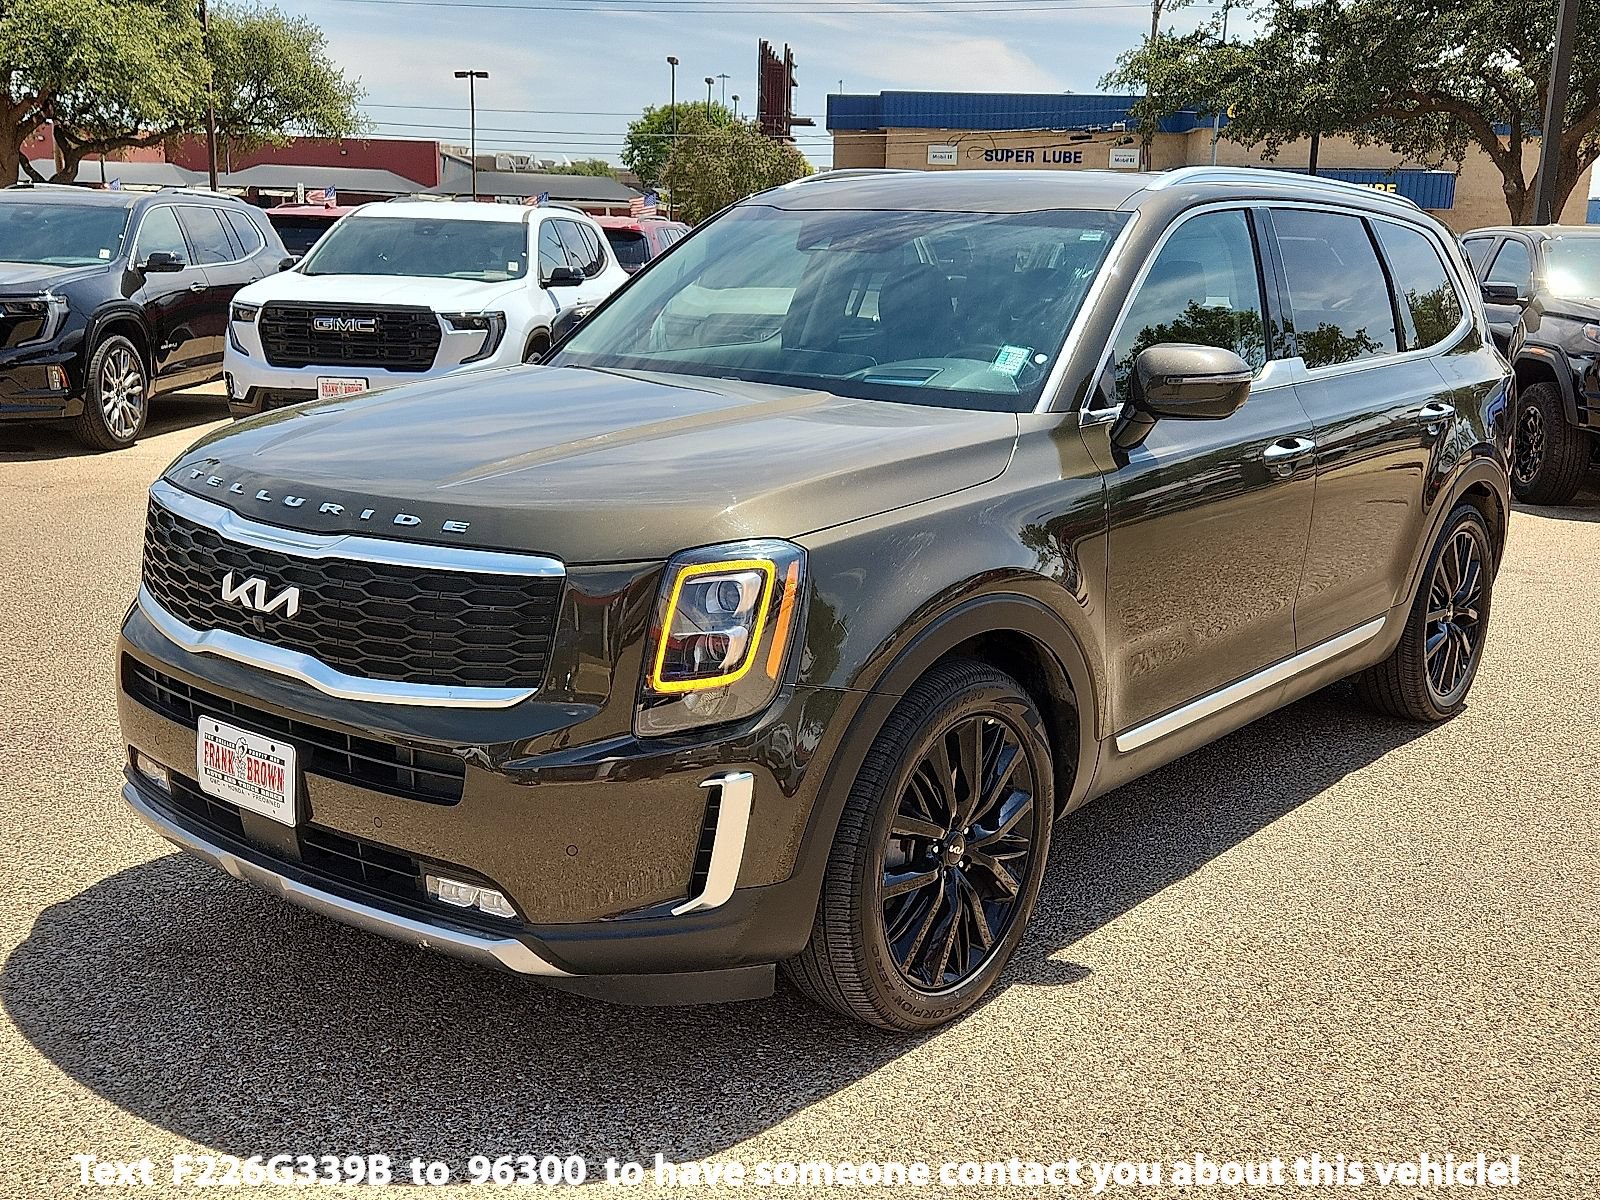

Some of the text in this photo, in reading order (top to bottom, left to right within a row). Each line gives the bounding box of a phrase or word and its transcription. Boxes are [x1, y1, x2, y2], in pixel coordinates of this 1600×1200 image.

[985, 150, 1083, 164] SUPER LUBE
[313, 317, 376, 333] GMC
[190, 468, 470, 533] TELLURIDE
[221, 570, 301, 618] KIA
[204, 740, 285, 795] FRANK BROWN
[227, 783, 245, 795] HONDA
[238, 780, 259, 794] TRUCK
[894, 996, 962, 1019] SCORPION
